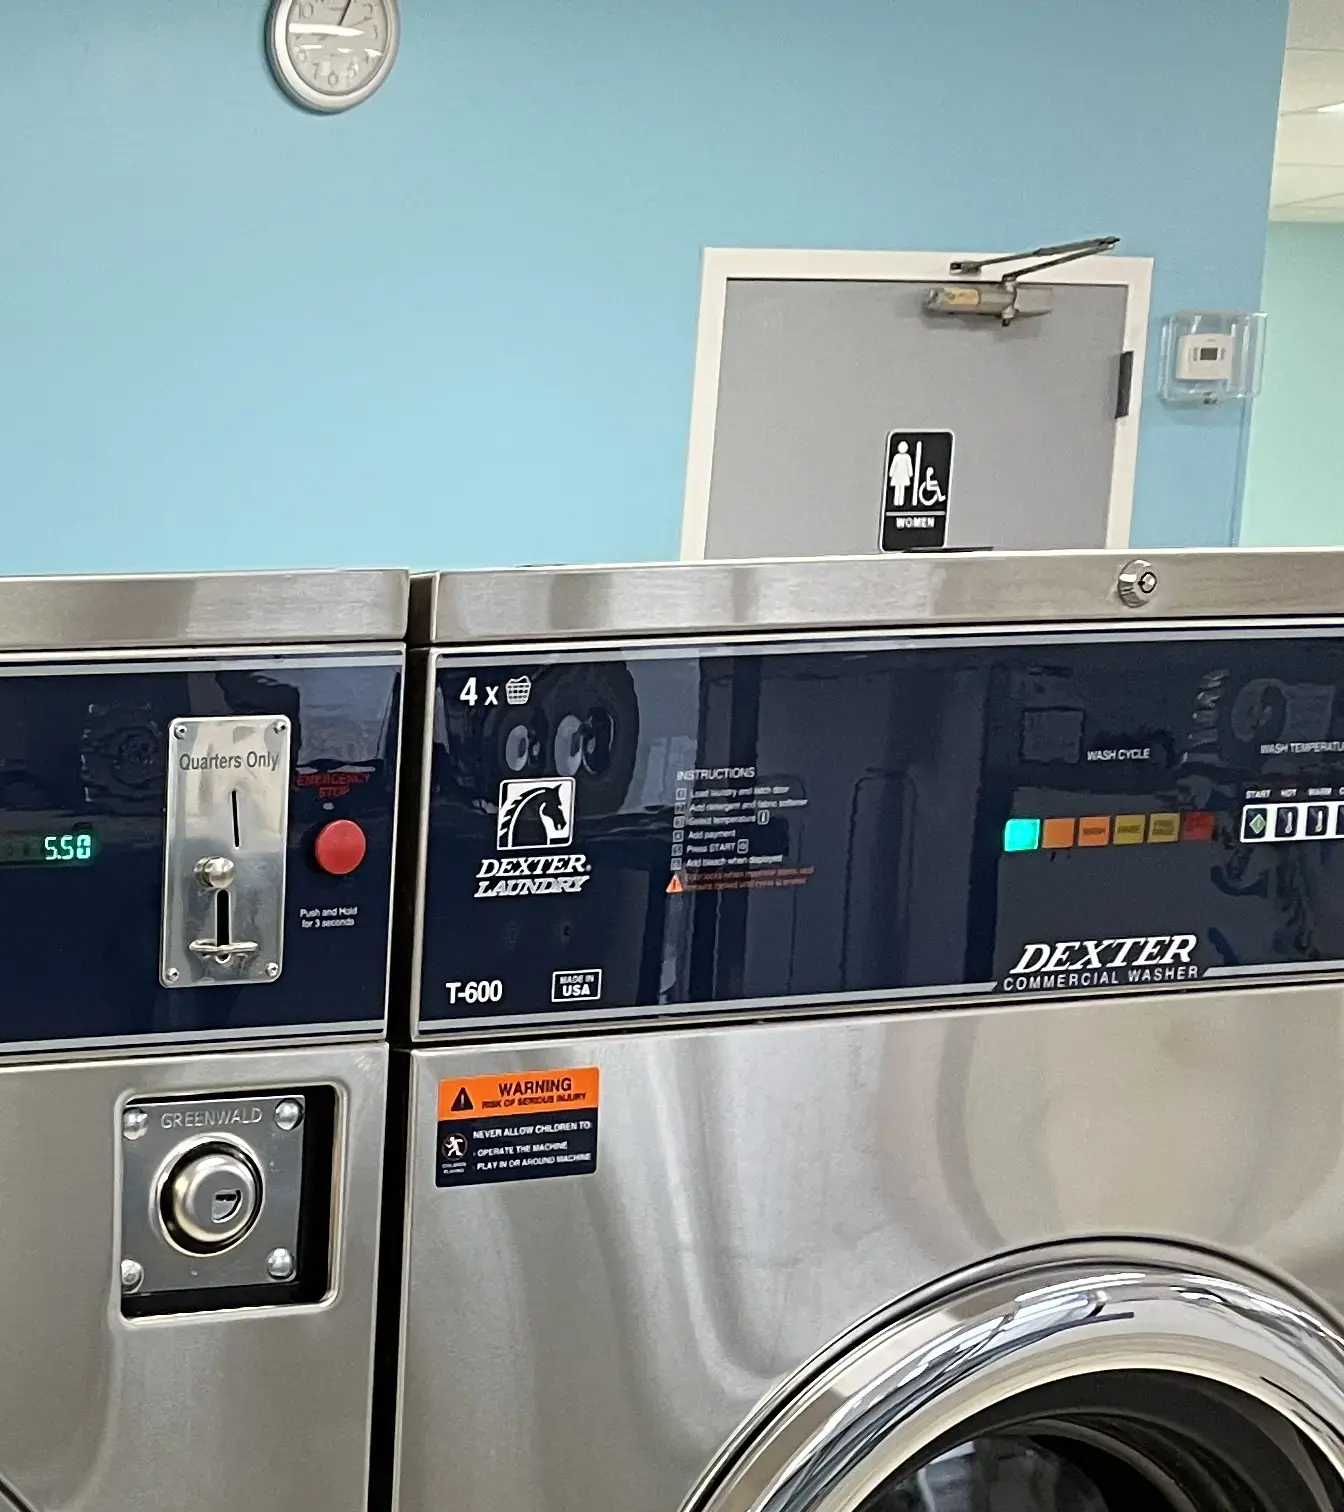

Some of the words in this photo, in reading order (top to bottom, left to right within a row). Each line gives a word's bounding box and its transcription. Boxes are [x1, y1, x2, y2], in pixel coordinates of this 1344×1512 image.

[896, 517, 934, 528] WOMEN
[460, 678, 478, 706] 4
[484, 687, 499, 706] x
[179, 754, 241, 771] Quarters
[246, 752, 278, 771] Only
[1087, 750, 1116, 760] WASH
[1118, 748, 1150, 760] CYCLE
[676, 767, 755, 781] INSTRUCTIONS
[45, 834, 90, 861] 5.50
[474, 875, 590, 898] LAUNDRY
[1010, 934, 1197, 974] DEXTER
[1004, 970, 1119, 991] COMMERCIAL
[1128, 966, 1198, 983] WASHER
[447, 980, 502, 1003] T-600
[499, 1078, 572, 1097] WARNING
[160, 1107, 262, 1128] GREENWALD
